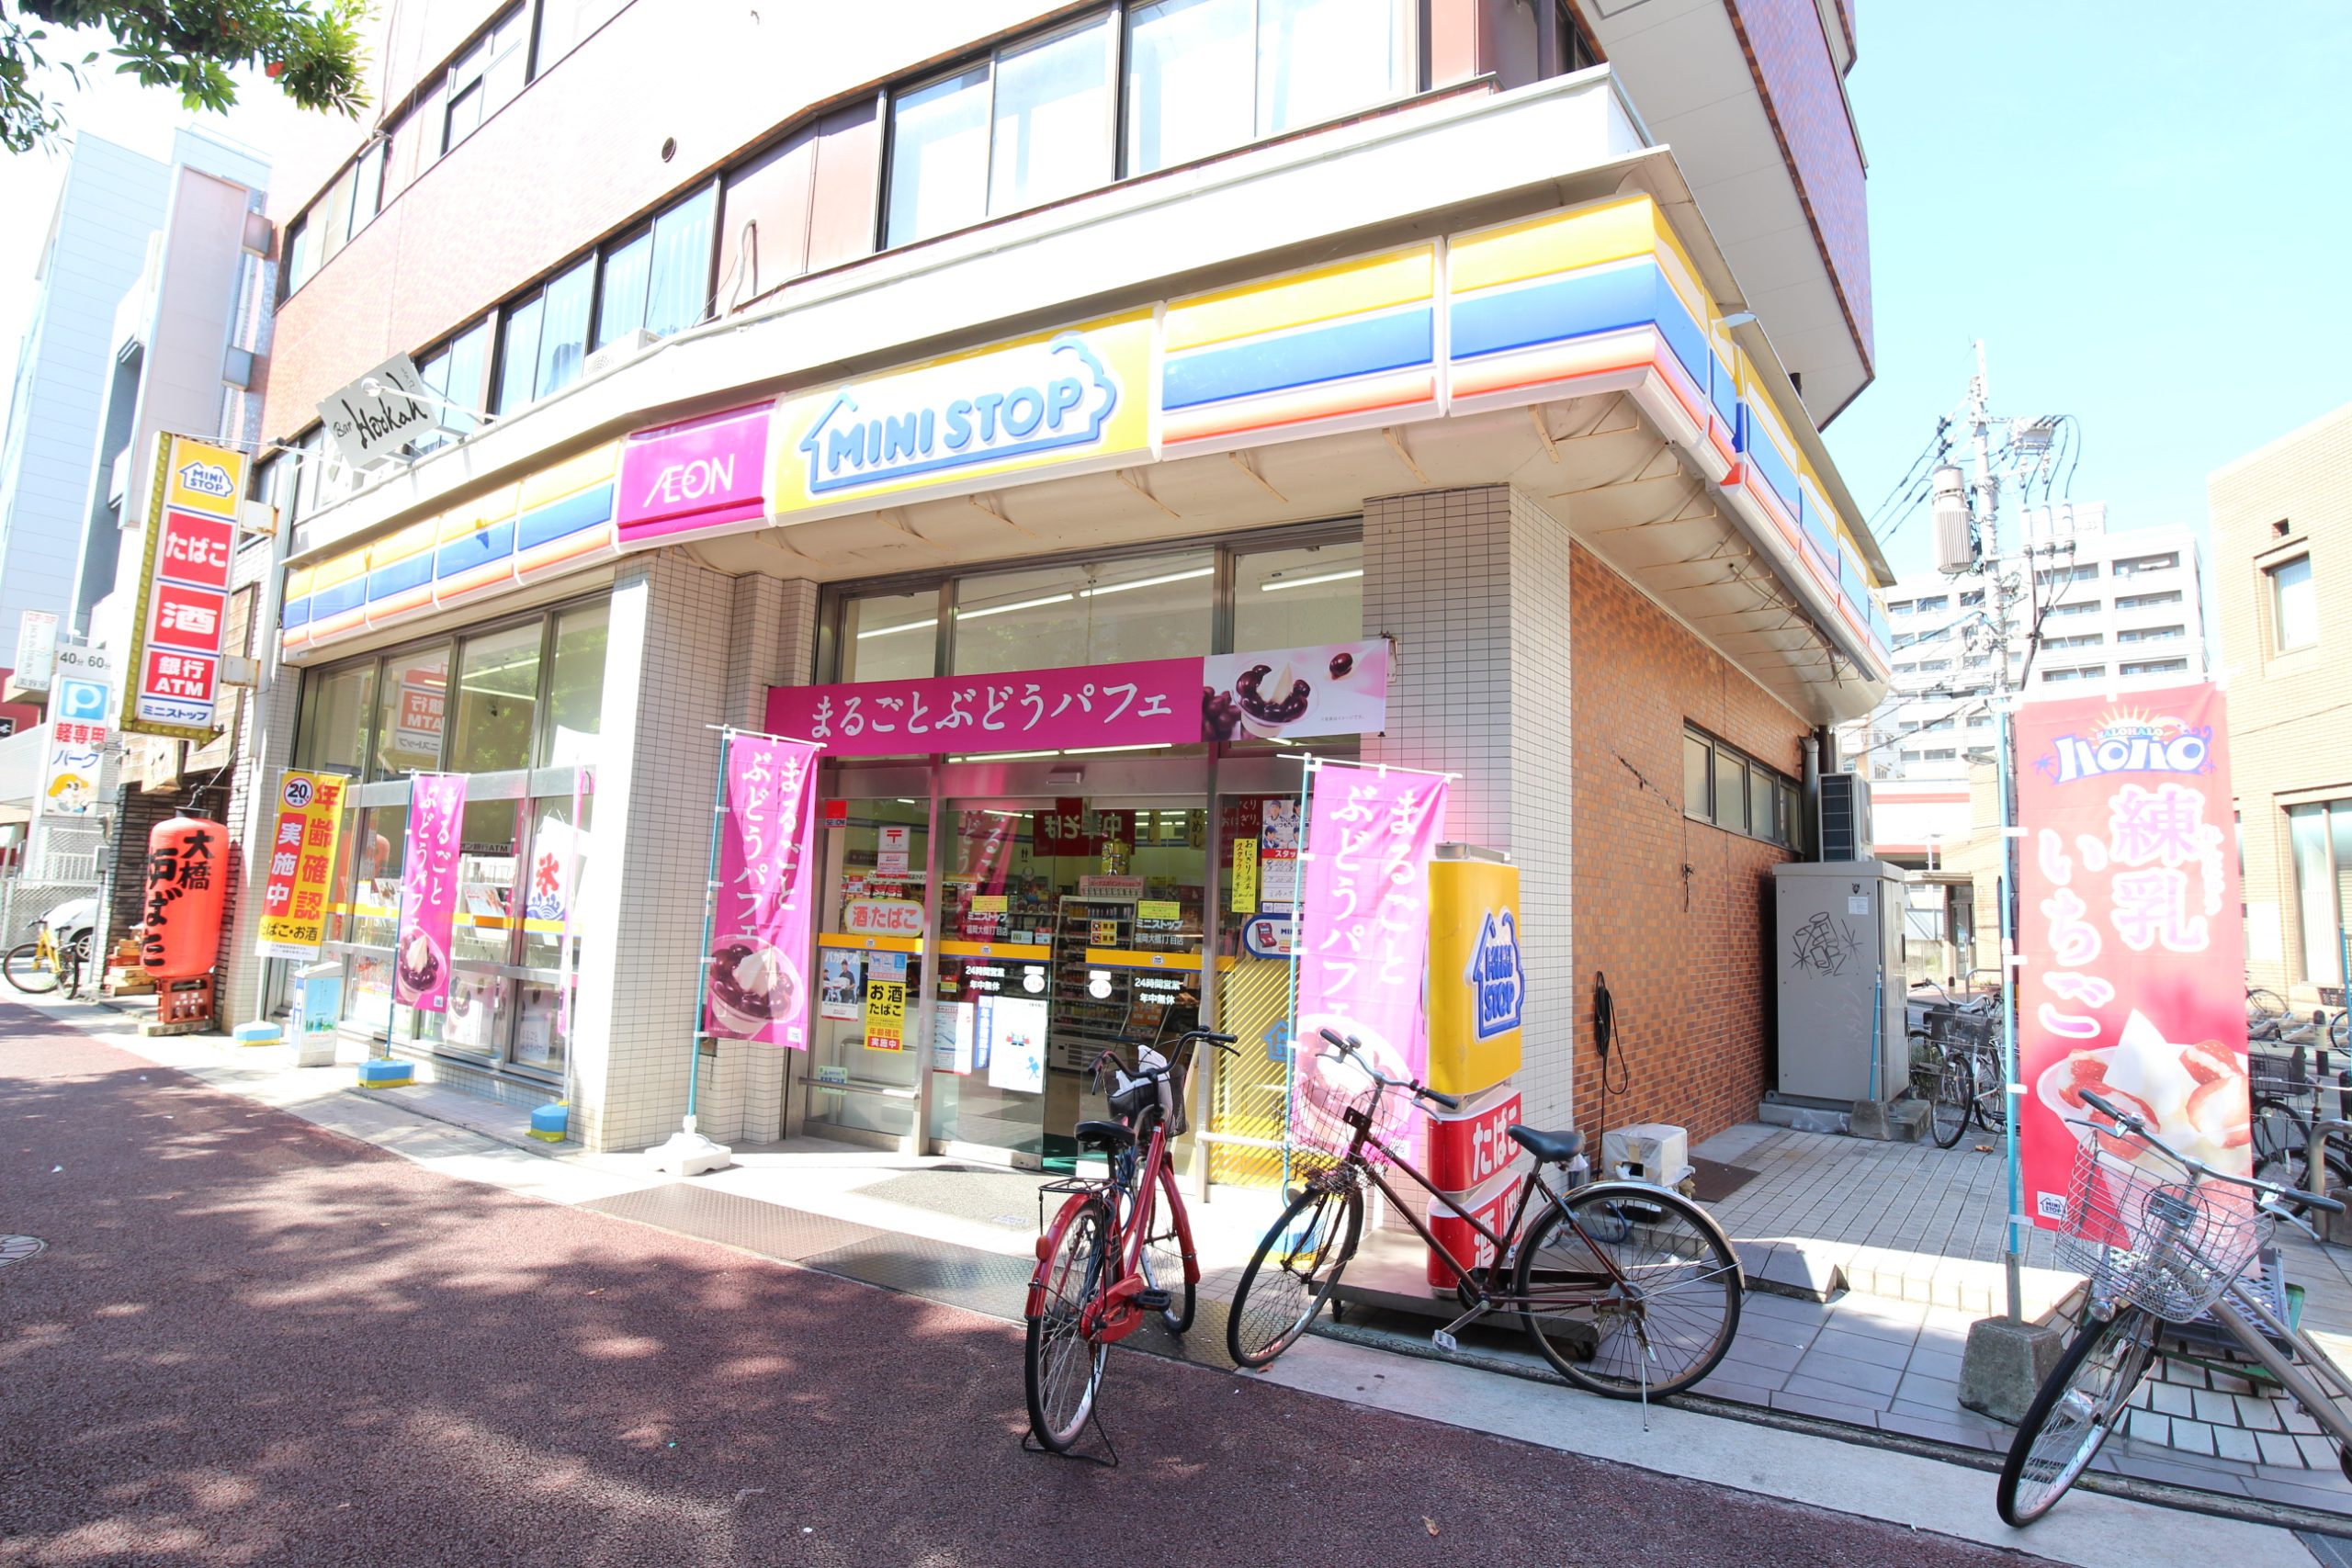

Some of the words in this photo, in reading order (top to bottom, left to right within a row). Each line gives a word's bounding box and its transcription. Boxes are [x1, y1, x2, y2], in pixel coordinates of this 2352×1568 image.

[342, 371, 428, 449] Hookah
[829, 408, 933, 474] MINI
[944, 377, 1082, 448] STOP
[334, 421, 352, 437] Bar
[190, 478, 223, 492] STOP
[192, 468, 223, 483] MINI
[165, 532, 227, 568] たばこ
[161, 602, 218, 635] 酒
[158, 656, 205, 679] 銀行
[154, 679, 204, 697] ATM
[142, 705, 209, 721] ミニストップ
[810, 682, 1172, 739] まるごとぶどうパフェ
[55, 723, 107, 743] 軽専用
[2096, 727, 2165, 739] HALOHALO
[52, 750, 100, 769] パーク
[431, 786, 458, 905] まるごと
[734, 751, 772, 940] ぶどうパフェ
[777, 756, 804, 910] まるごと
[176, 830, 214, 890] 大橋
[266, 822, 303, 908] 実施中
[294, 782, 341, 921] 年齢確認
[411, 786, 440, 929] ぶどうパフェ
[2109, 783, 2211, 953] 練乳
[536, 852, 560, 897] 氷
[1379, 789, 1420, 985] まるごと
[967, 912, 1009, 922] ミニストップ
[1318, 784, 1374, 1018] ぶどうパフェ
[1136, 919, 1183, 931] ミニストップ
[2037, 828, 2115, 1039] いちご
[1486, 945, 1513, 981] MINI
[870, 985, 903, 1003] お酒
[1135, 977, 1181, 990] 24時間営業
[1139, 993, 1175, 1005] 年中無休
[869, 1003, 902, 1017] たばこ
[1485, 982, 1514, 1021] STOP
[869, 1027, 900, 1038] 年齢確認
[870, 1037, 897, 1048] 実施中
